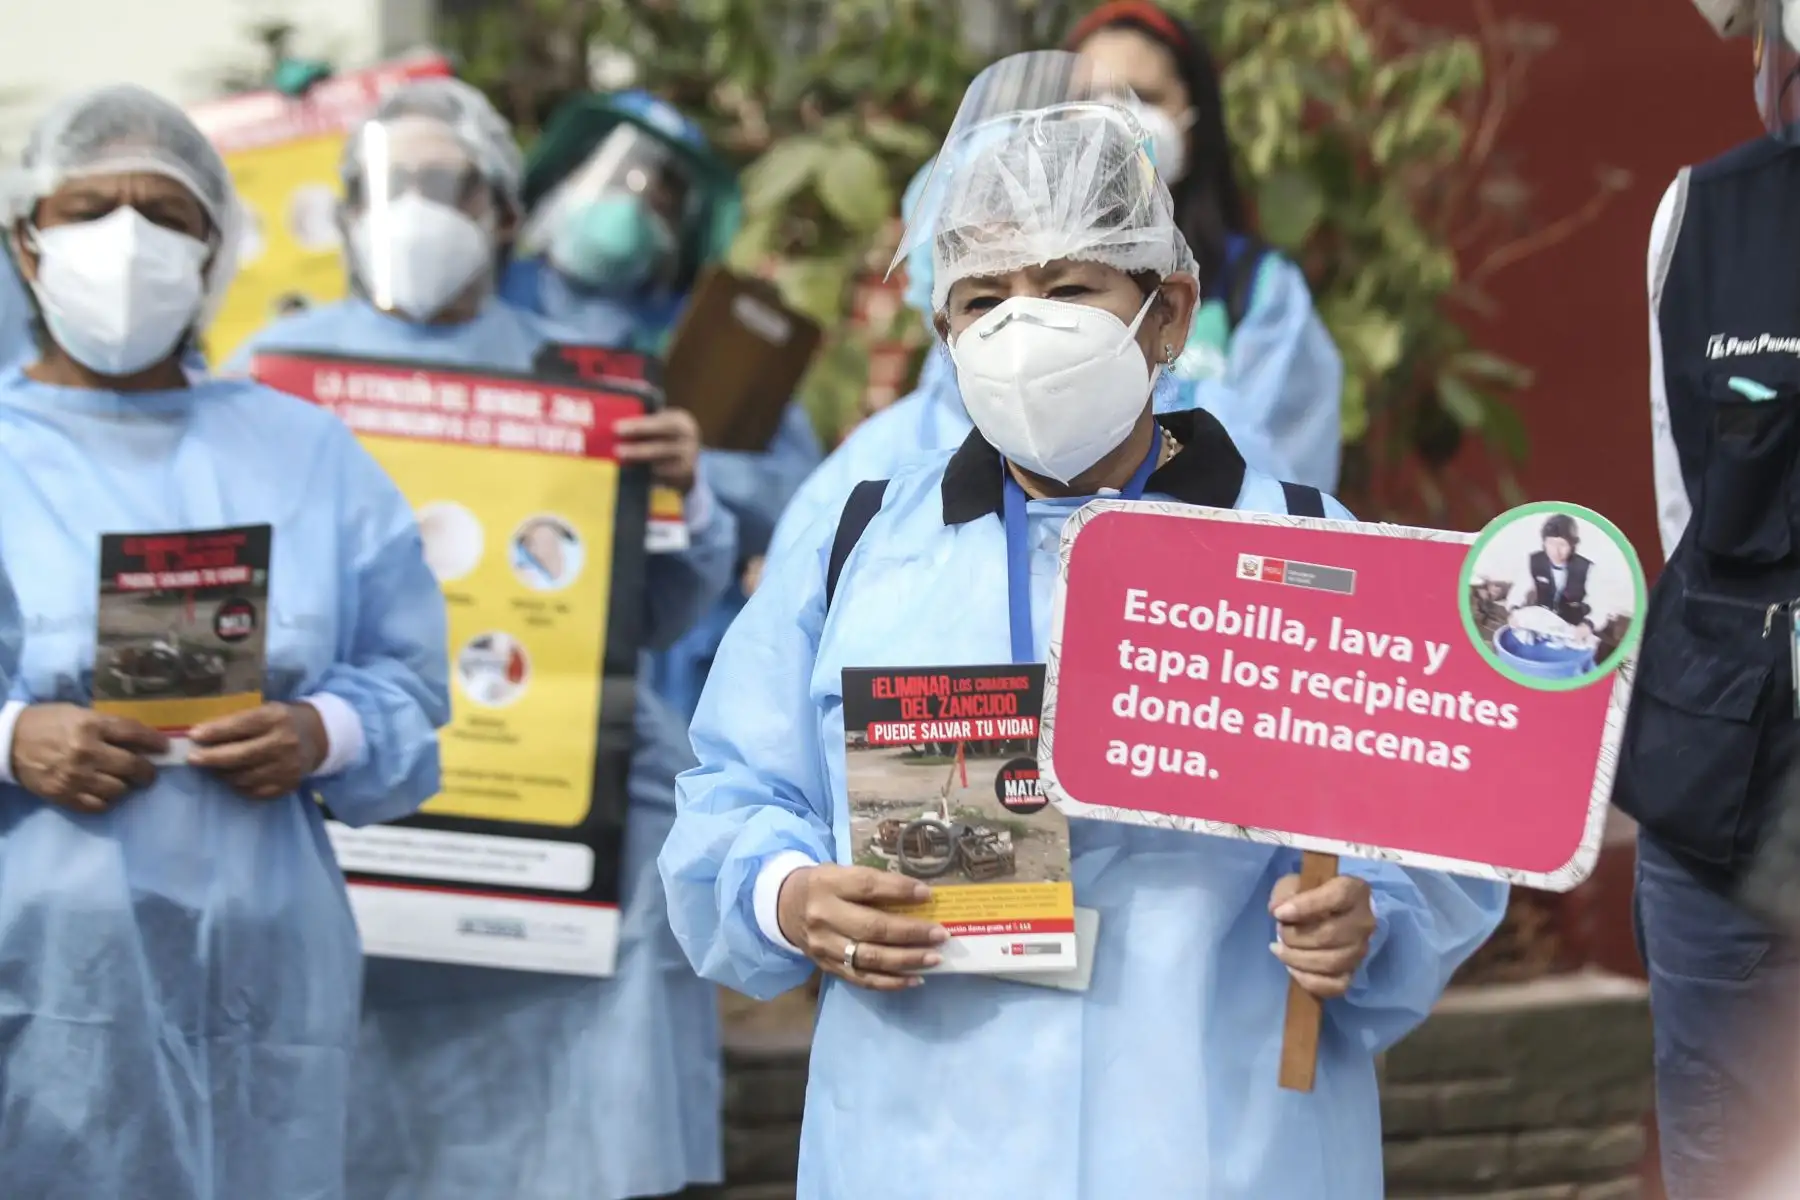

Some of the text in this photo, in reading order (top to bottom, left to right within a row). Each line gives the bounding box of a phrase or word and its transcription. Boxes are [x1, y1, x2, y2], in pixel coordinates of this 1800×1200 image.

[1124, 588, 1450, 675] Escobilla, lava y
[872, 675, 950, 698] ¡ELIMINAR
[953, 679, 973, 692] LOS
[1118, 639, 1519, 730] tapa los recipientes
[901, 693, 1017, 720] DEL ZANCUDO
[874, 718, 1034, 741] PUEDE SALVAR TU VIDA!
[1112, 684, 1471, 771] donde almacenas
[1106, 739, 1219, 779] agua.
[1005, 779, 1045, 796] MATA
